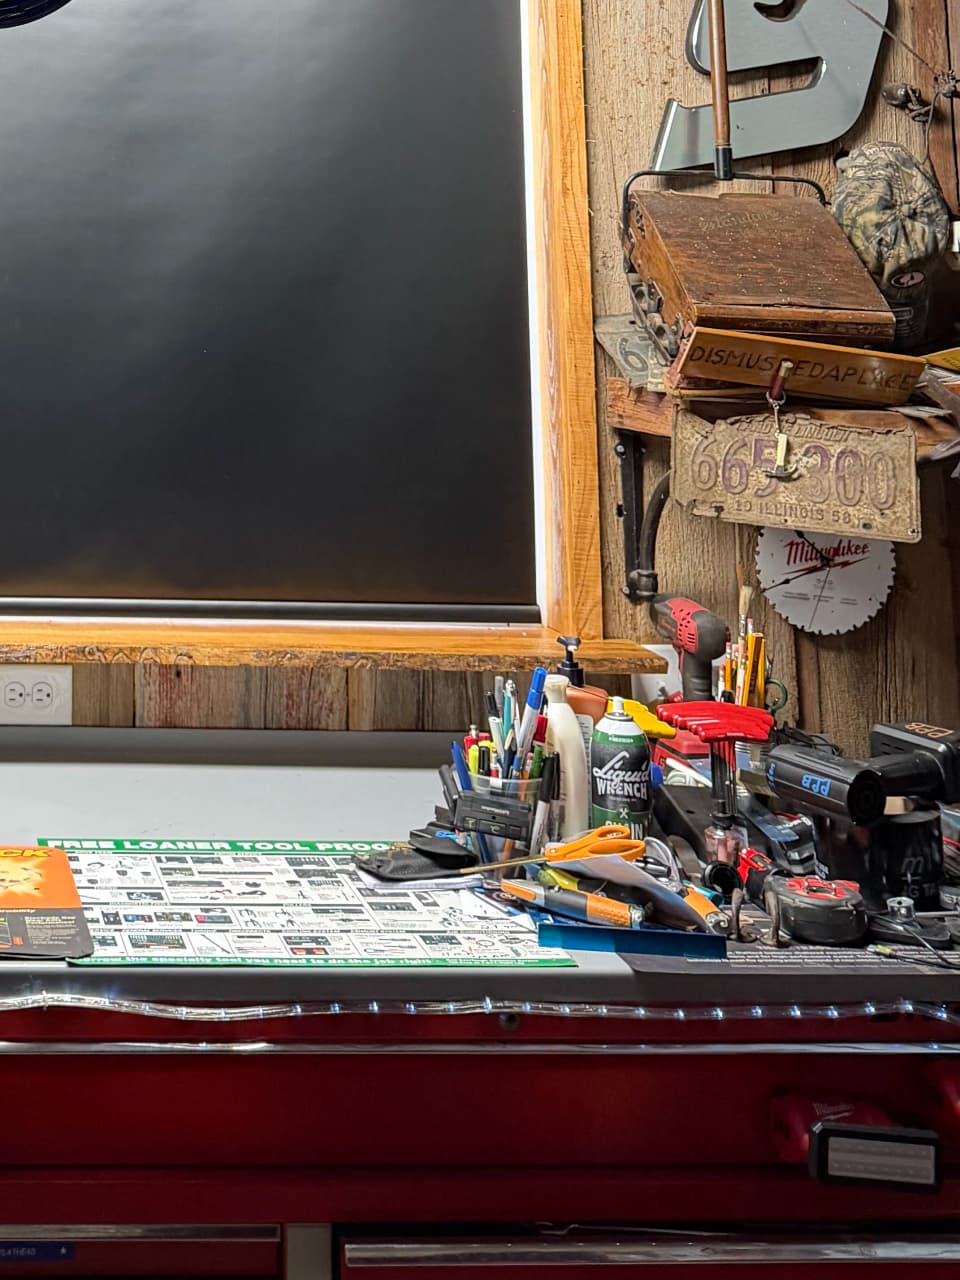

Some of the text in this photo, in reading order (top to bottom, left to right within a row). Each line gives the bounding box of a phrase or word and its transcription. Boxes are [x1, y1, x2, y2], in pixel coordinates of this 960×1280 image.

[759, 503, 825, 522] ILLINOIS
[784, 538, 871, 566] Milwaukee
[593, 750, 650, 789] Liquid
[596, 777, 648, 801] WRENCH
[46, 840, 116, 849] FREE
[123, 840, 226, 851] LOANER
[236, 841, 304, 851] TOOL
